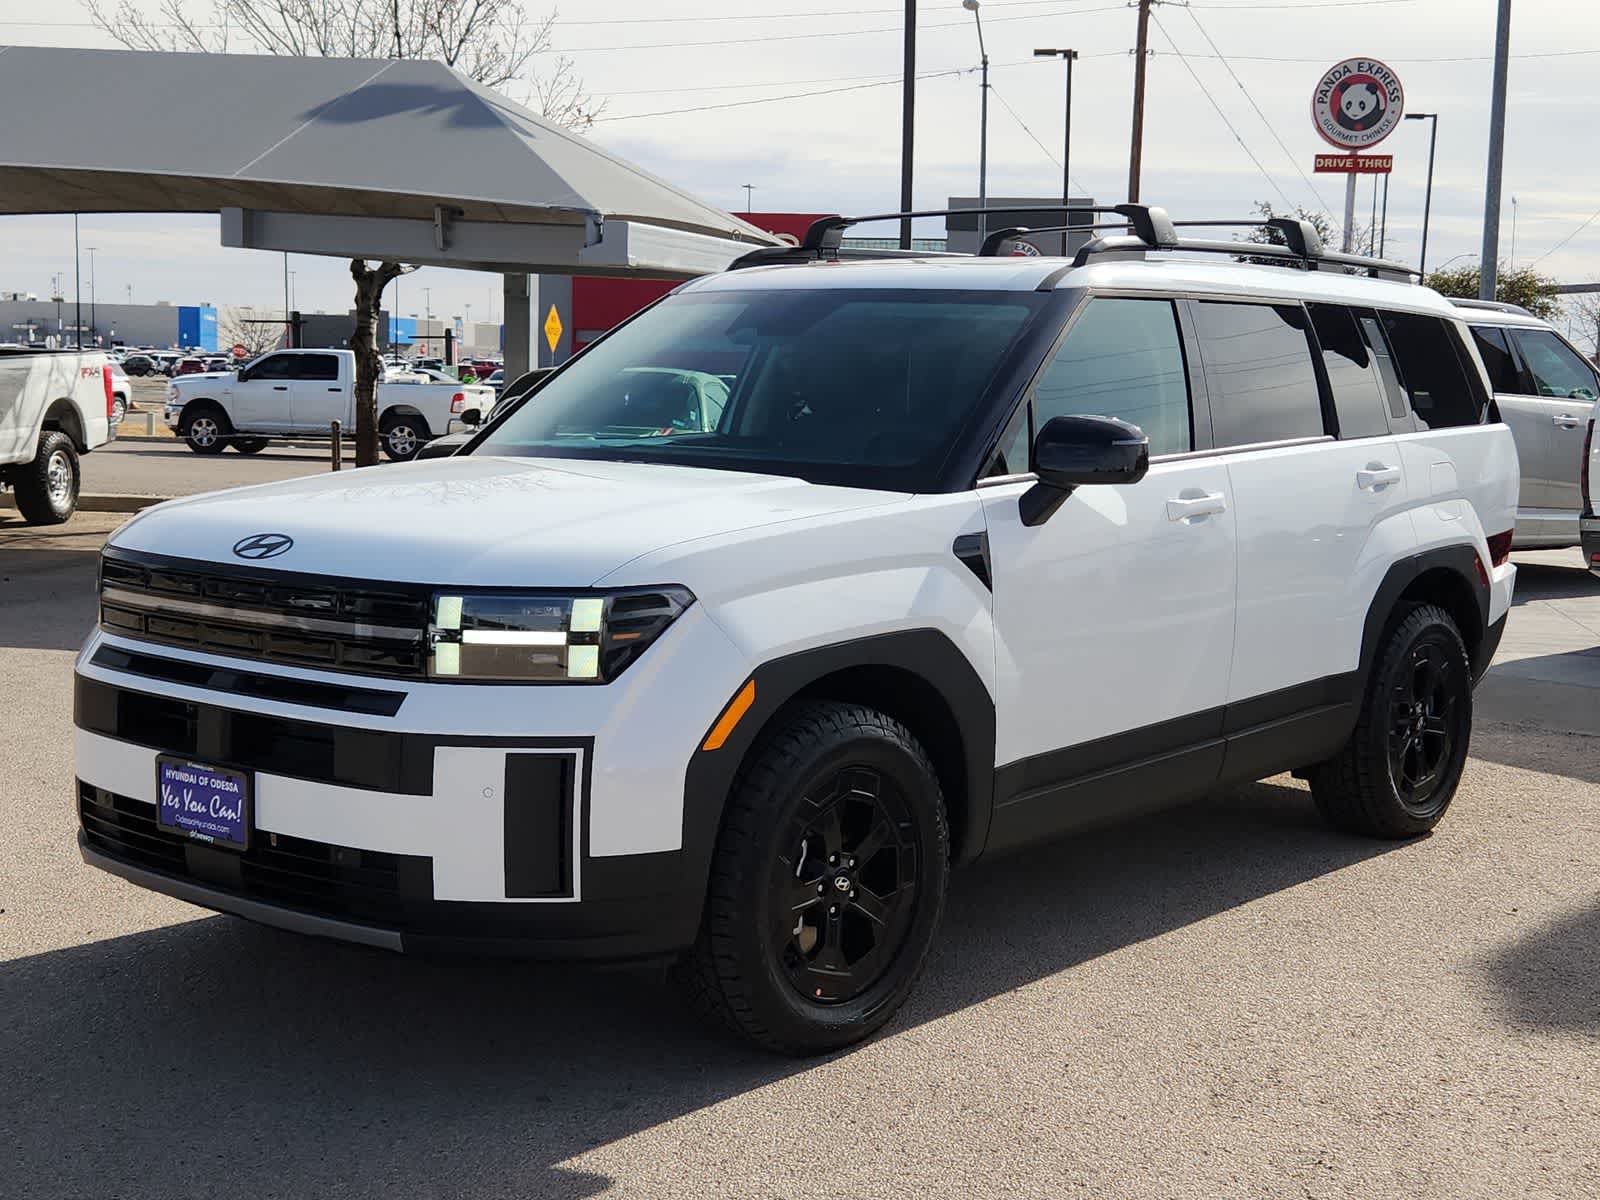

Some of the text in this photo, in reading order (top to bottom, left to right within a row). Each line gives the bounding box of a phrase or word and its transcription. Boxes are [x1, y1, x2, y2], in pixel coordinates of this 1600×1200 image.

[1317, 62, 1400, 105] PANDA EXPRESS
[1323, 118, 1392, 142] GOURMET CHINESE
[1315, 158, 1392, 168] DRIVE THRU
[165, 768, 239, 794] HYUNDAI OF ODESSA
[161, 784, 242, 823] Yes You Can!
